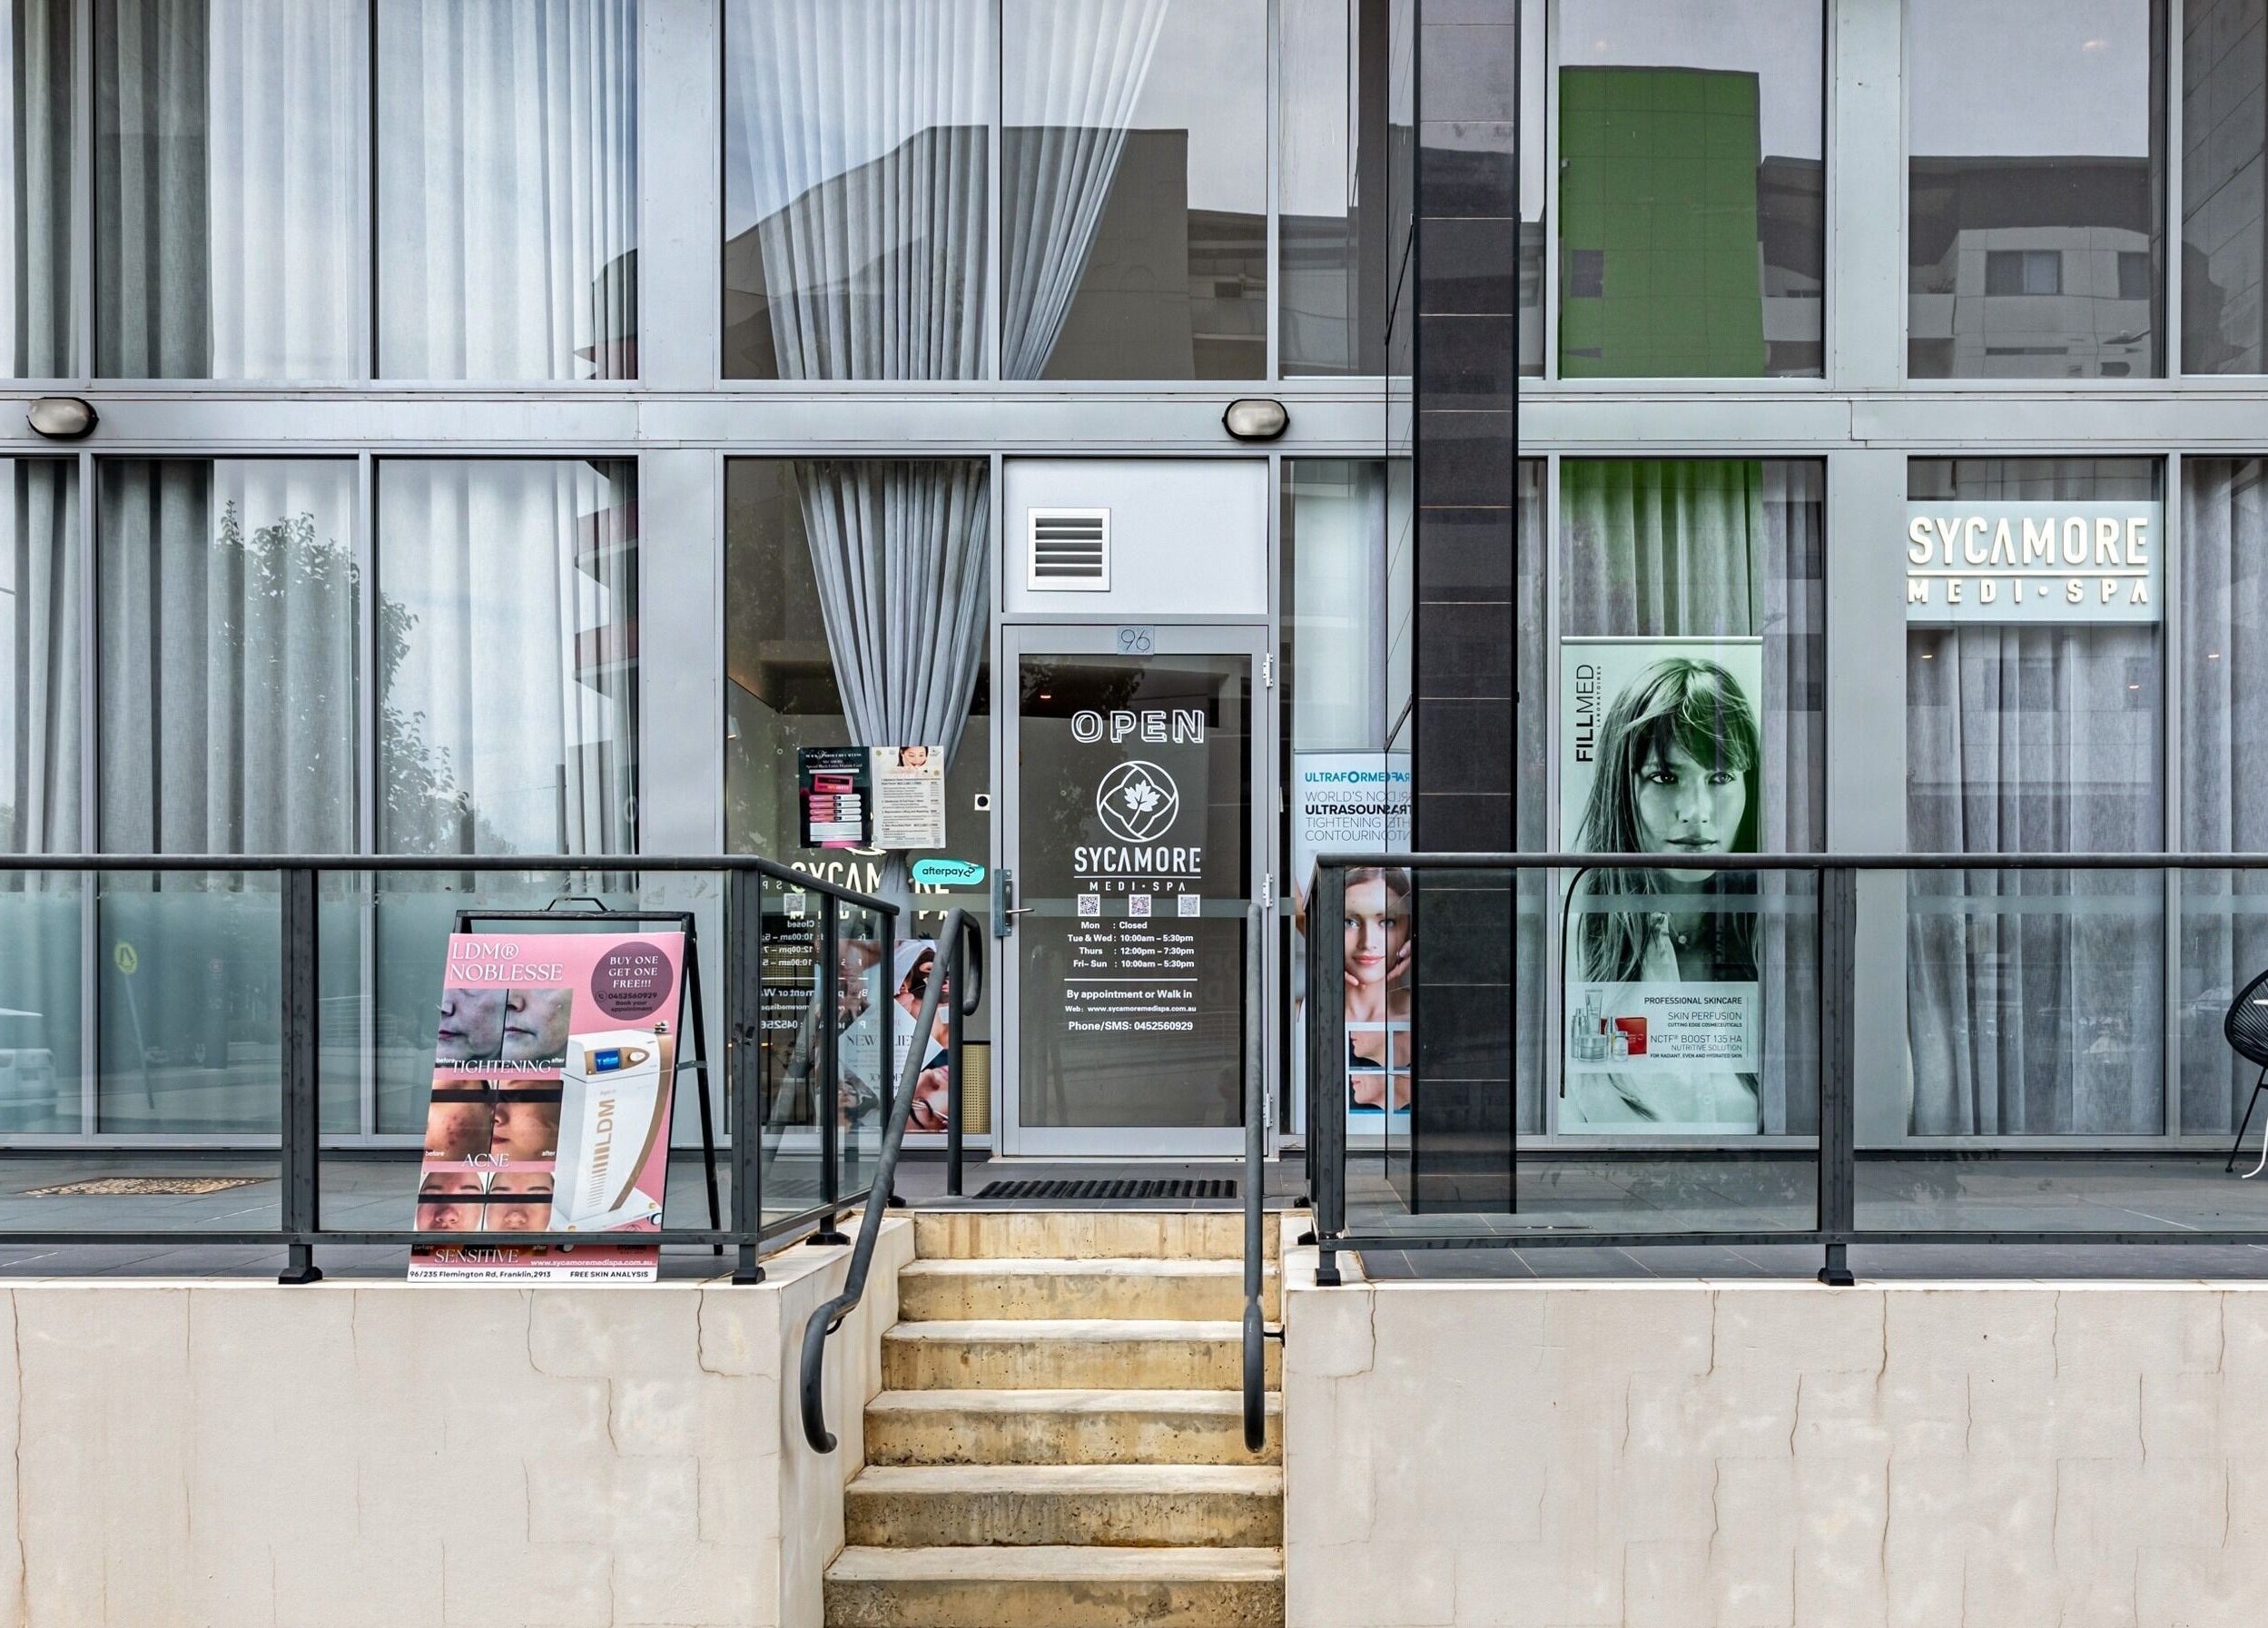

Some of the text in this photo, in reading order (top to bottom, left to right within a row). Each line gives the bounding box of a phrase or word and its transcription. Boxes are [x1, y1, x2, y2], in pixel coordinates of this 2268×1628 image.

[1908, 517, 2148, 564] SYCAMORE
[1121, 628, 1150, 651] 96
[1576, 665, 1593, 762] FILLMED
[1071, 710, 1204, 743] OPEN
[1305, 771, 1385, 783] ULTRAFORME
[1305, 791, 1363, 802] WORLD'S
[1306, 804, 1385, 815] ULTRASOUN
[1306, 817, 1380, 828] TIGHTENING
[1074, 846, 1201, 872] SYCAMORE
[922, 867, 962, 877] afterpay
[1162, 934, 1194, 943] 5:30pm
[1120, 947, 1156, 956] 12:00pm
[1163, 947, 1195, 956] 7:30pm
[610, 956, 658, 965] BUY ONE
[1090, 960, 1108, 968] Sun
[1121, 960, 1156, 968] 10:00am
[1163, 960, 1195, 969] 5:30pm
[449, 963, 563, 982] NOBLESSE
[608, 967, 658, 977] GET ONE
[613, 979, 652, 989] FREE!!!
[1067, 990, 1079, 1000] By
[1080, 991, 1143, 1000] appointment
[1157, 990, 1181, 999] Walk
[1183, 990, 1193, 999] in
[1643, 997, 1742, 1005] PROFESSIONAL SKINCARE
[1088, 1005, 1197, 1013] www.sycamoremedispa.com.au
[1668, 1011, 1742, 1021] SKIN PERFUSION
[1069, 1021, 1193, 1031] Phone/SMS: 0452560929
[1681, 1034, 1711, 1043] BOOST
[1713, 1034, 1728, 1043] 135
[1730, 1034, 1742, 1043] HA
[453, 1060, 551, 1074] TIGHTENING
[462, 1153, 509, 1168] ACNE
[434, 1248, 519, 1264] SENSITIVE
[439, 1271, 484, 1279] Flemington
